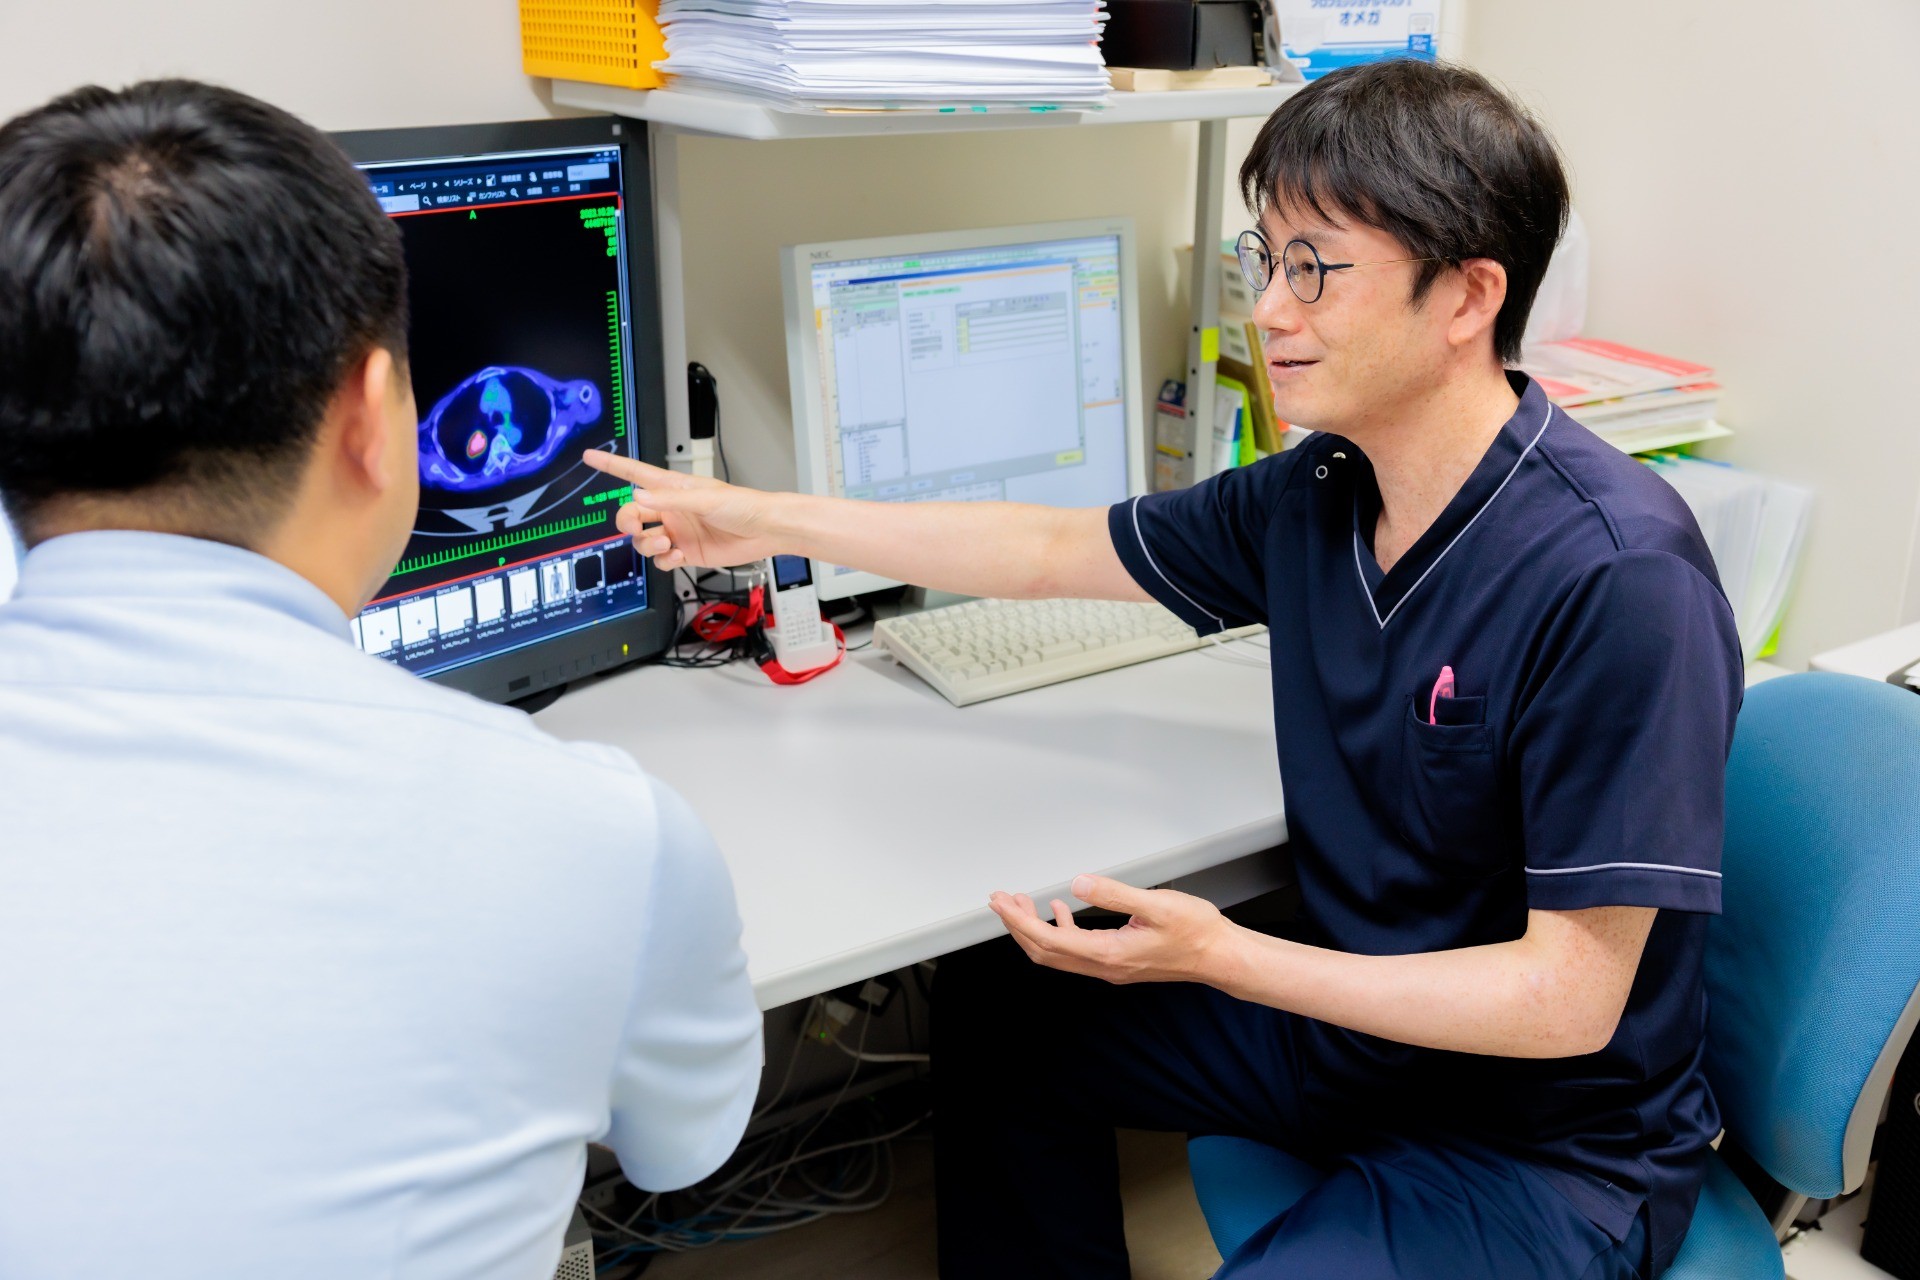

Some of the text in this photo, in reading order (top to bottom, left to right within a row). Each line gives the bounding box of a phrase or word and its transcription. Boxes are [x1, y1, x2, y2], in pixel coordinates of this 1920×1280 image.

[1340, 10, 1381, 26] オメガ
[410, 181, 427, 190] ページ
[453, 177, 474, 187] シリーズ
[469, 209, 477, 219] A
[809, 249, 832, 259] NEC
[498, 556, 506, 567] P
